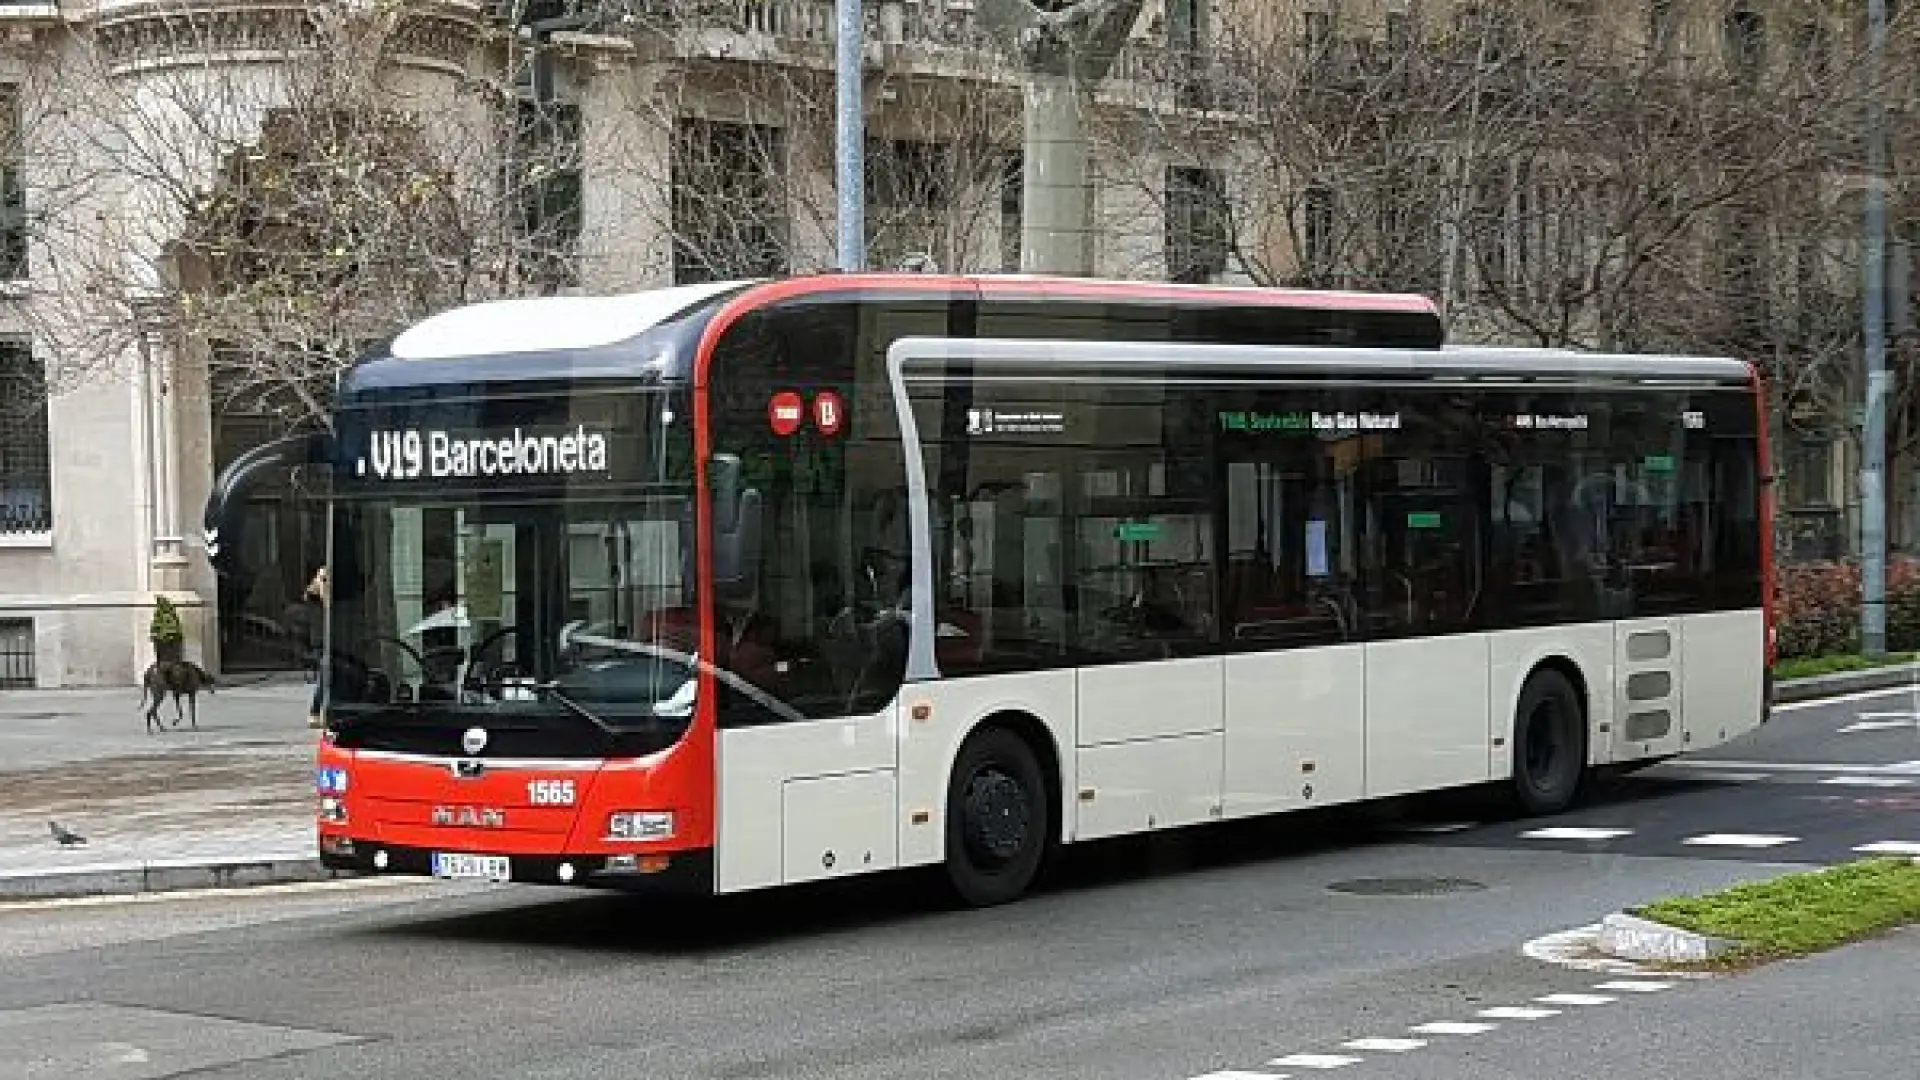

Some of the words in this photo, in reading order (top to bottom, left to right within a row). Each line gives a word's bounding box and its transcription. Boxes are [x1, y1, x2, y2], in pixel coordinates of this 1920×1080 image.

[370, 430, 422, 479] V19
[429, 424, 606, 476] Barceloneta
[527, 780, 575, 804] 1565
